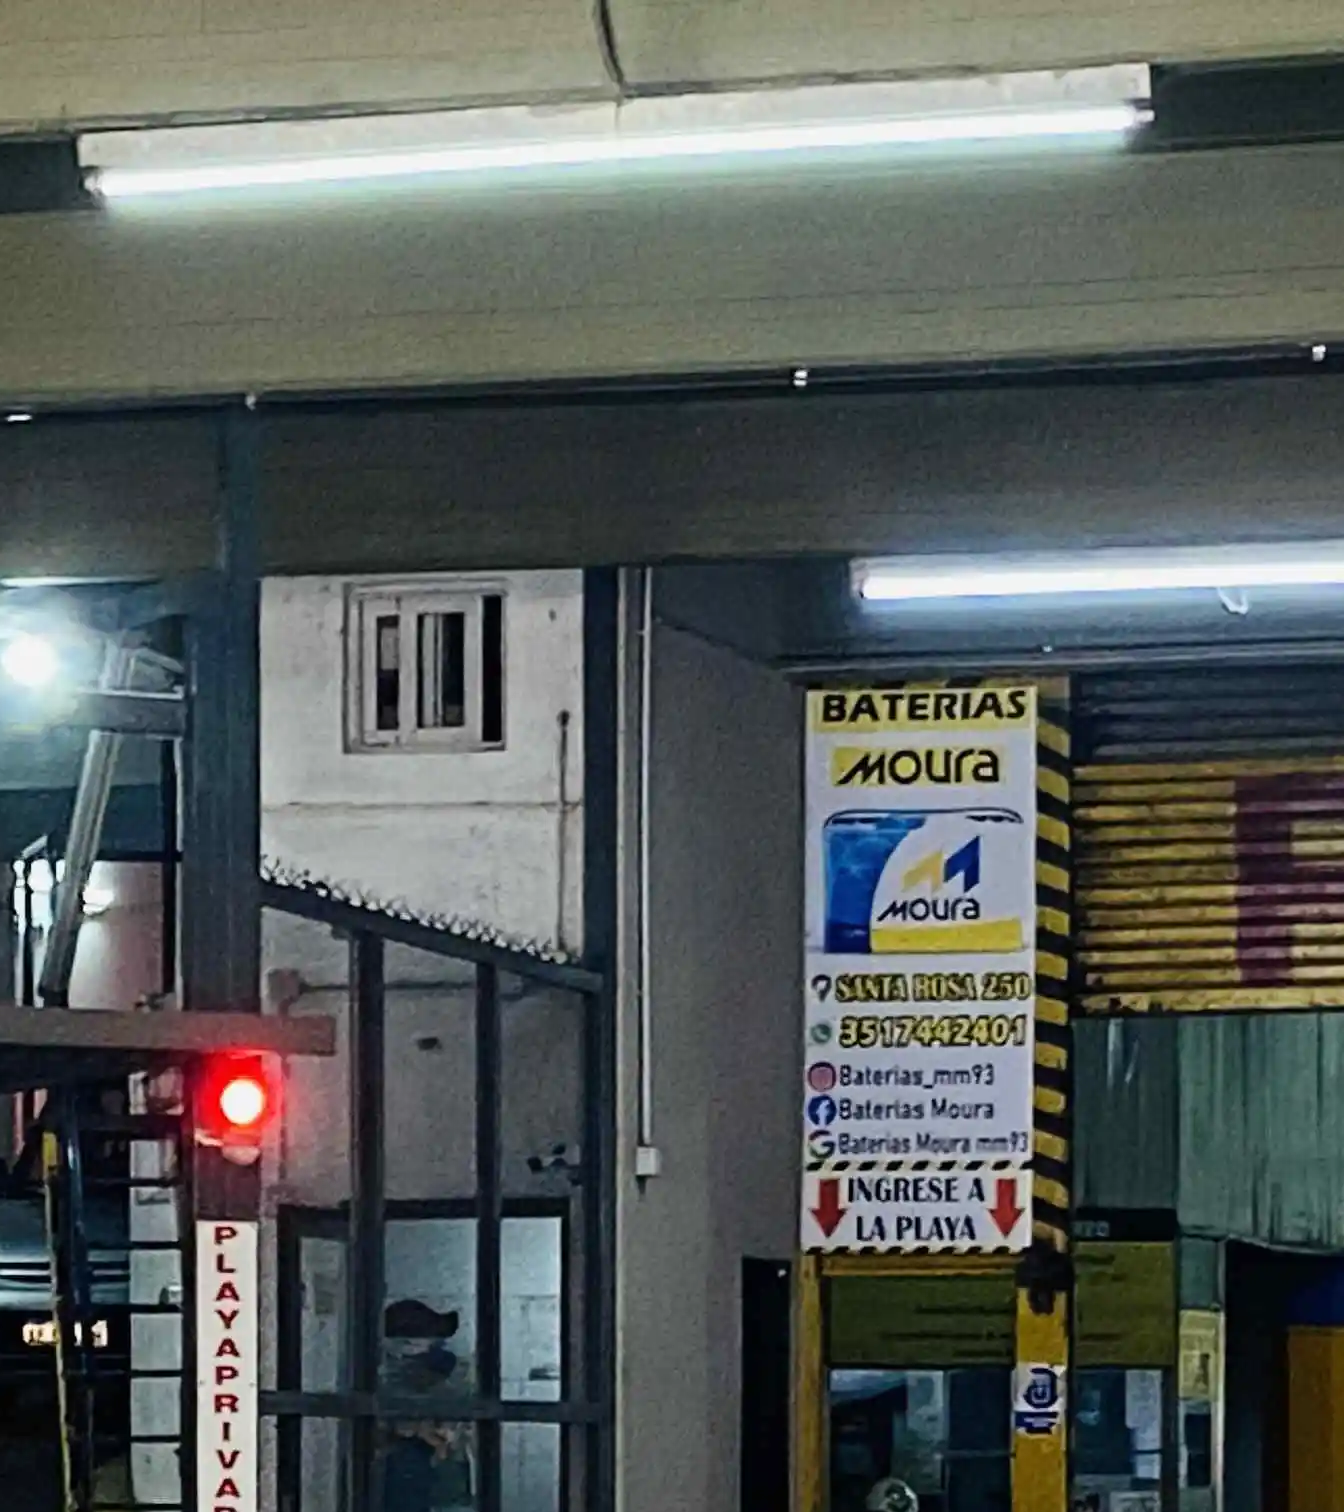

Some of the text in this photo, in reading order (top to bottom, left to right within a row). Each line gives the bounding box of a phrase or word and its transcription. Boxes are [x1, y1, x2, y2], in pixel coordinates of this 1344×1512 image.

[822, 690, 1026, 722] BATERIAS
[835, 972, 1032, 1002] SANTA ROSA 250
[839, 1014, 1027, 1048] 3517442401
[839, 1098, 924, 1120] Baterias
[931, 1097, 994, 1120] Moura
[916, 1131, 971, 1154] Moura
[848, 1176, 986, 1203] INGRESE A
[856, 1215, 977, 1241] LA PLAYA
